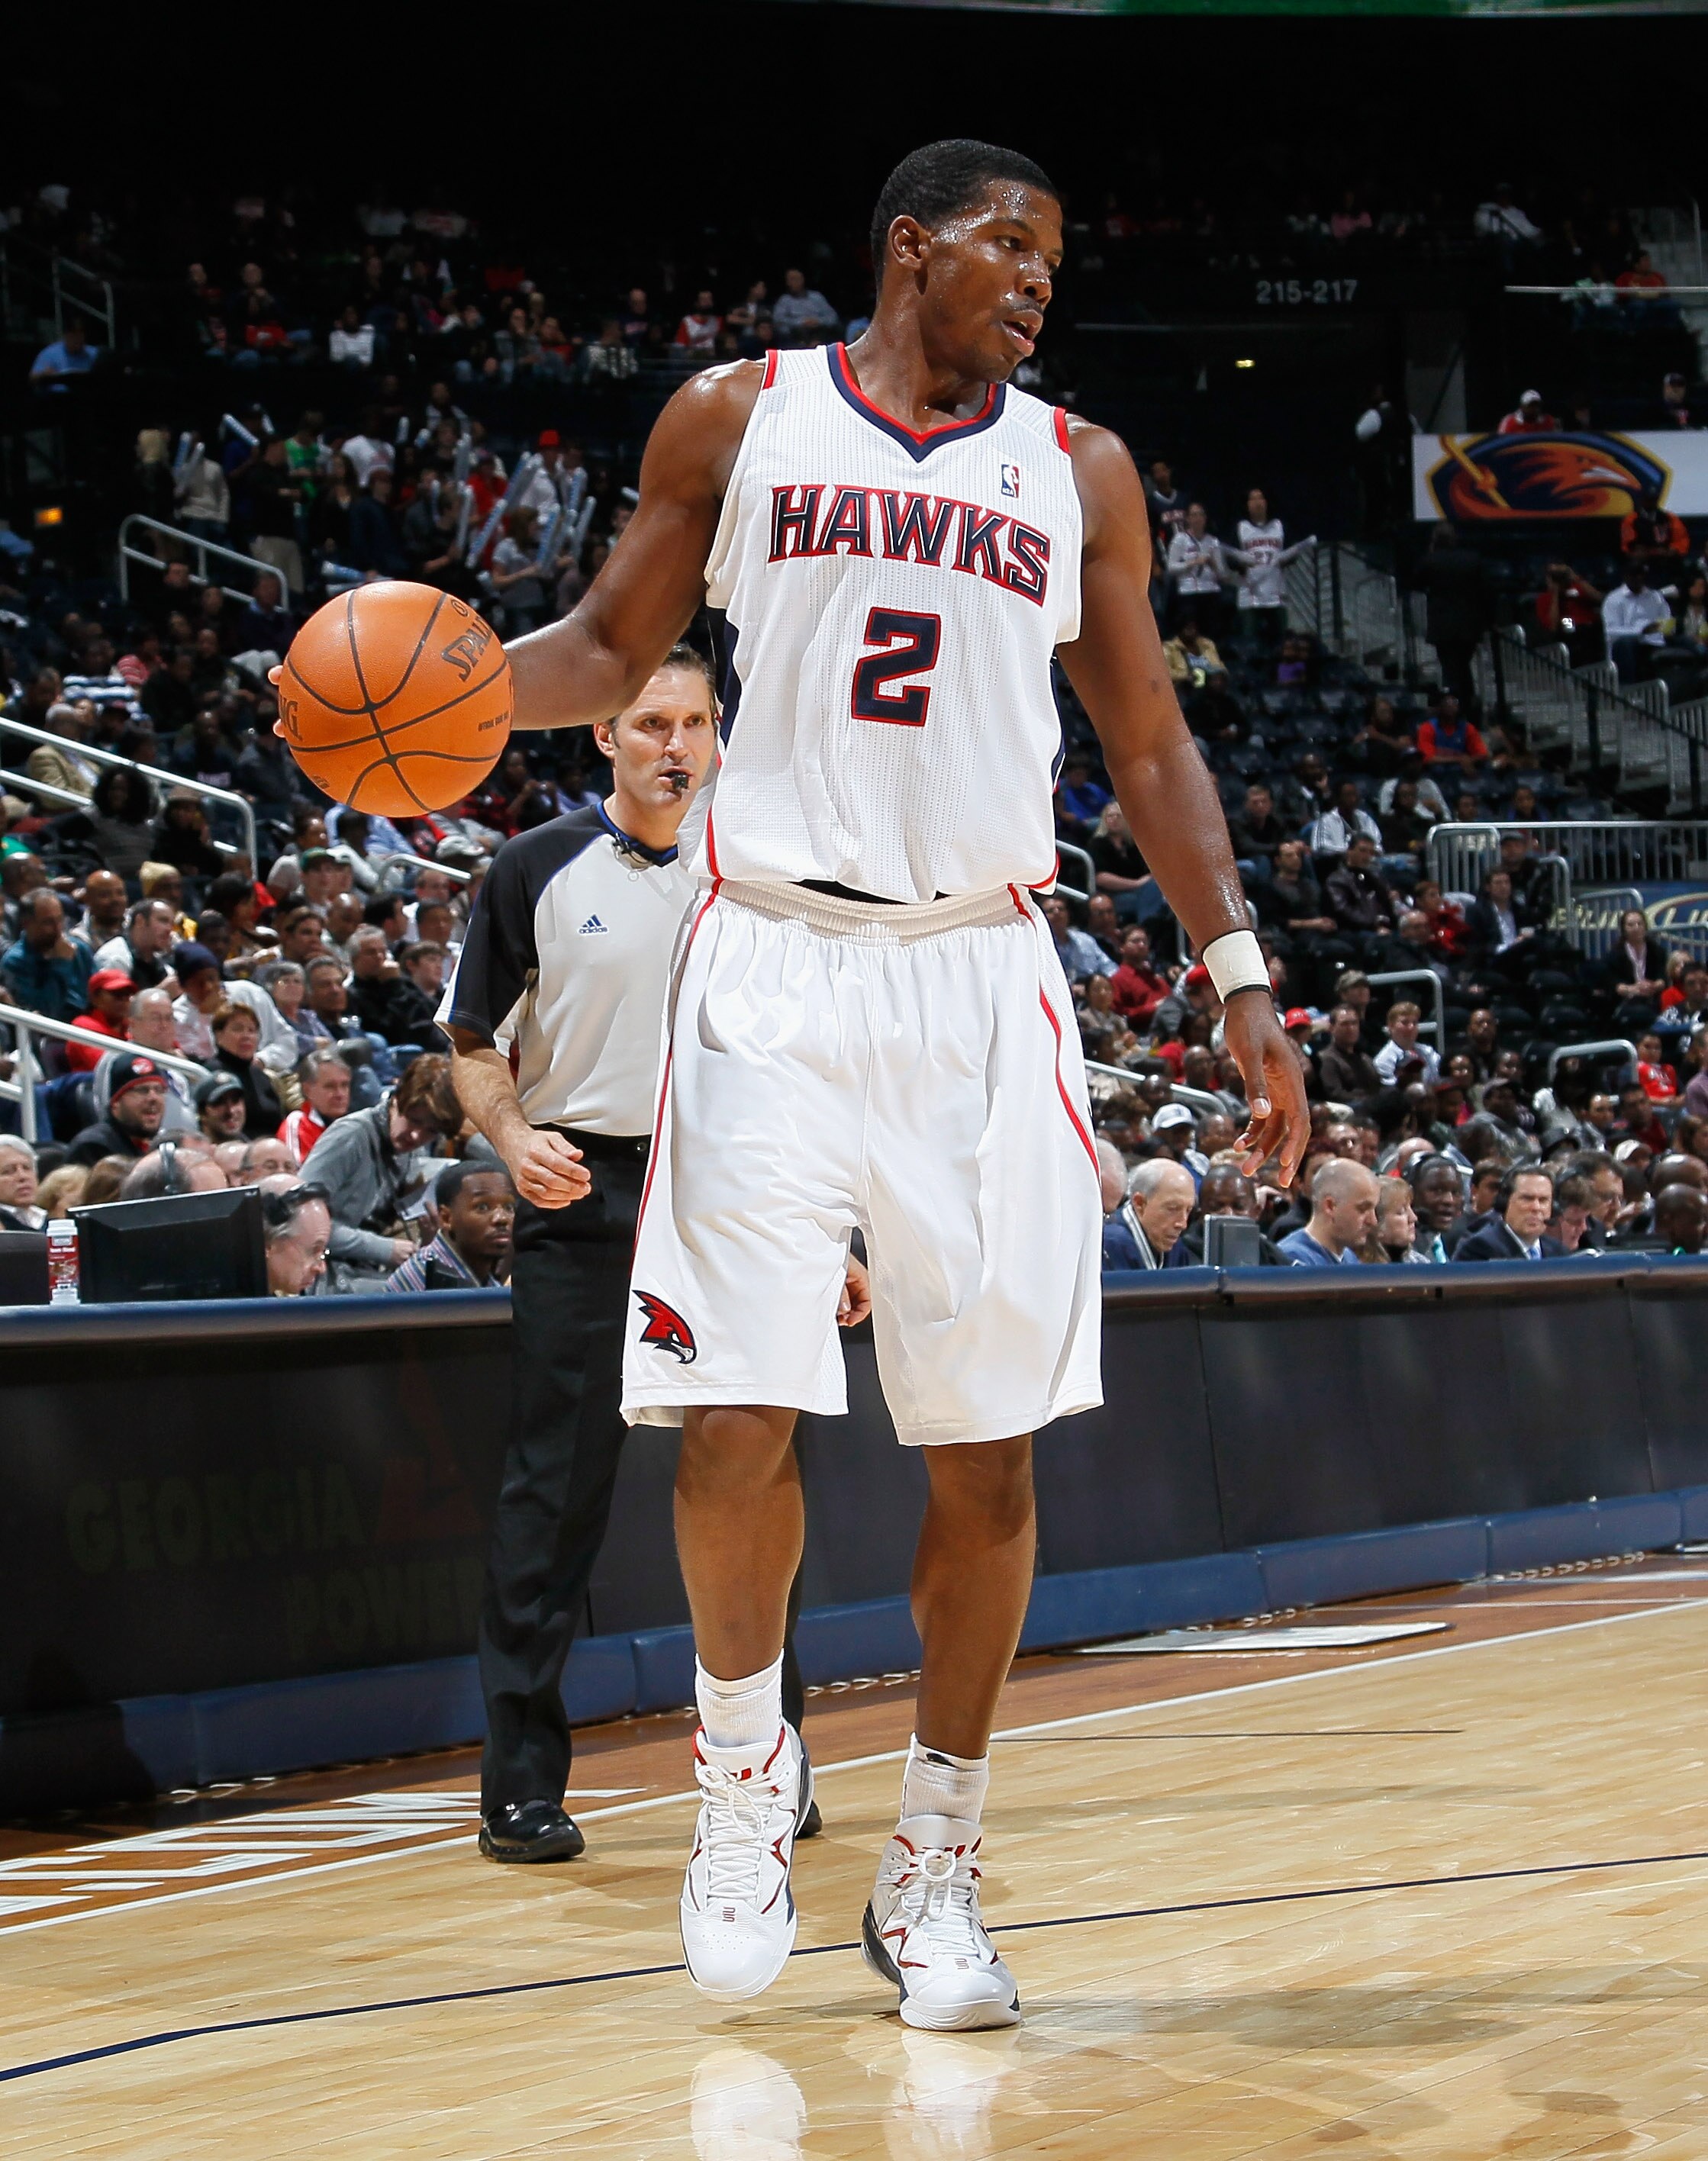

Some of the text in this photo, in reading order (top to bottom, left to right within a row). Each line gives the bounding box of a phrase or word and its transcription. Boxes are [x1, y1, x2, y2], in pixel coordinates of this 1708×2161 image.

[1256, 279, 1358, 304] 215-217
[768, 484, 1050, 607] HAWKS
[851, 607, 941, 727] 2
